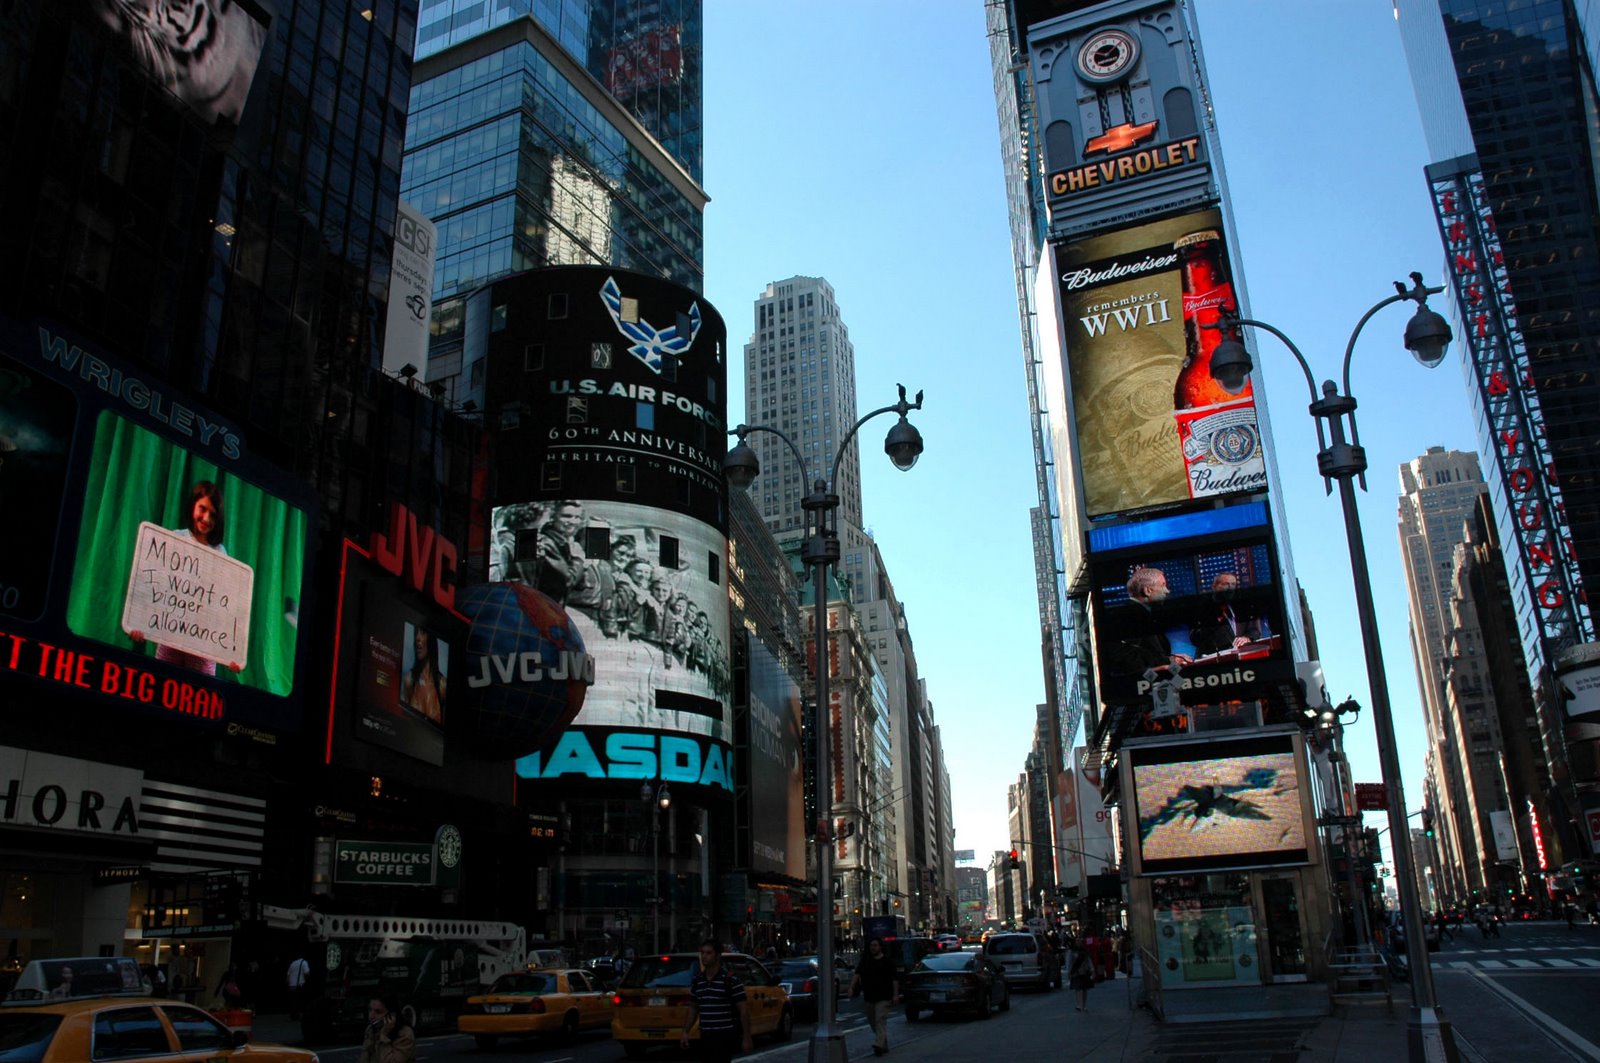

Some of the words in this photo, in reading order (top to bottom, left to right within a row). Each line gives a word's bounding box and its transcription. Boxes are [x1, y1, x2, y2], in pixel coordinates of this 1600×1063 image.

[1052, 137, 1199, 196] CHEVROLET
[1062, 252, 1178, 290] Budweiser
[1079, 298, 1172, 339] WWII
[1087, 290, 1160, 313] remembers
[37, 326, 241, 461] WRIGLEY'S
[549, 378, 604, 395] U.S.
[608, 380, 656, 402] AIR
[1443, 190, 1488, 338] ERNST
[1501, 429, 1564, 609] YOUNG
[549, 426, 600, 440] 60TH
[546, 453, 637, 464] HERITAGE
[374, 502, 458, 609] JVC
[142, 569, 160, 584] I
[168, 574, 216, 604] want
[219, 595, 229, 610] a
[152, 586, 203, 618] bigger
[148, 612, 238, 652] allowance!
[38, 642, 94, 689] THE
[100, 660, 156, 704] BIG
[467, 652, 543, 688] JVC
[551, 651, 595, 685] JVC
[750, 691, 781, 740] BIONIC
[750, 718, 786, 769] WOMAN
[99, 868, 141, 879] SEPHORA
[339, 850, 431, 865] STARBUCKS
[355, 863, 415, 877] COFFEE
